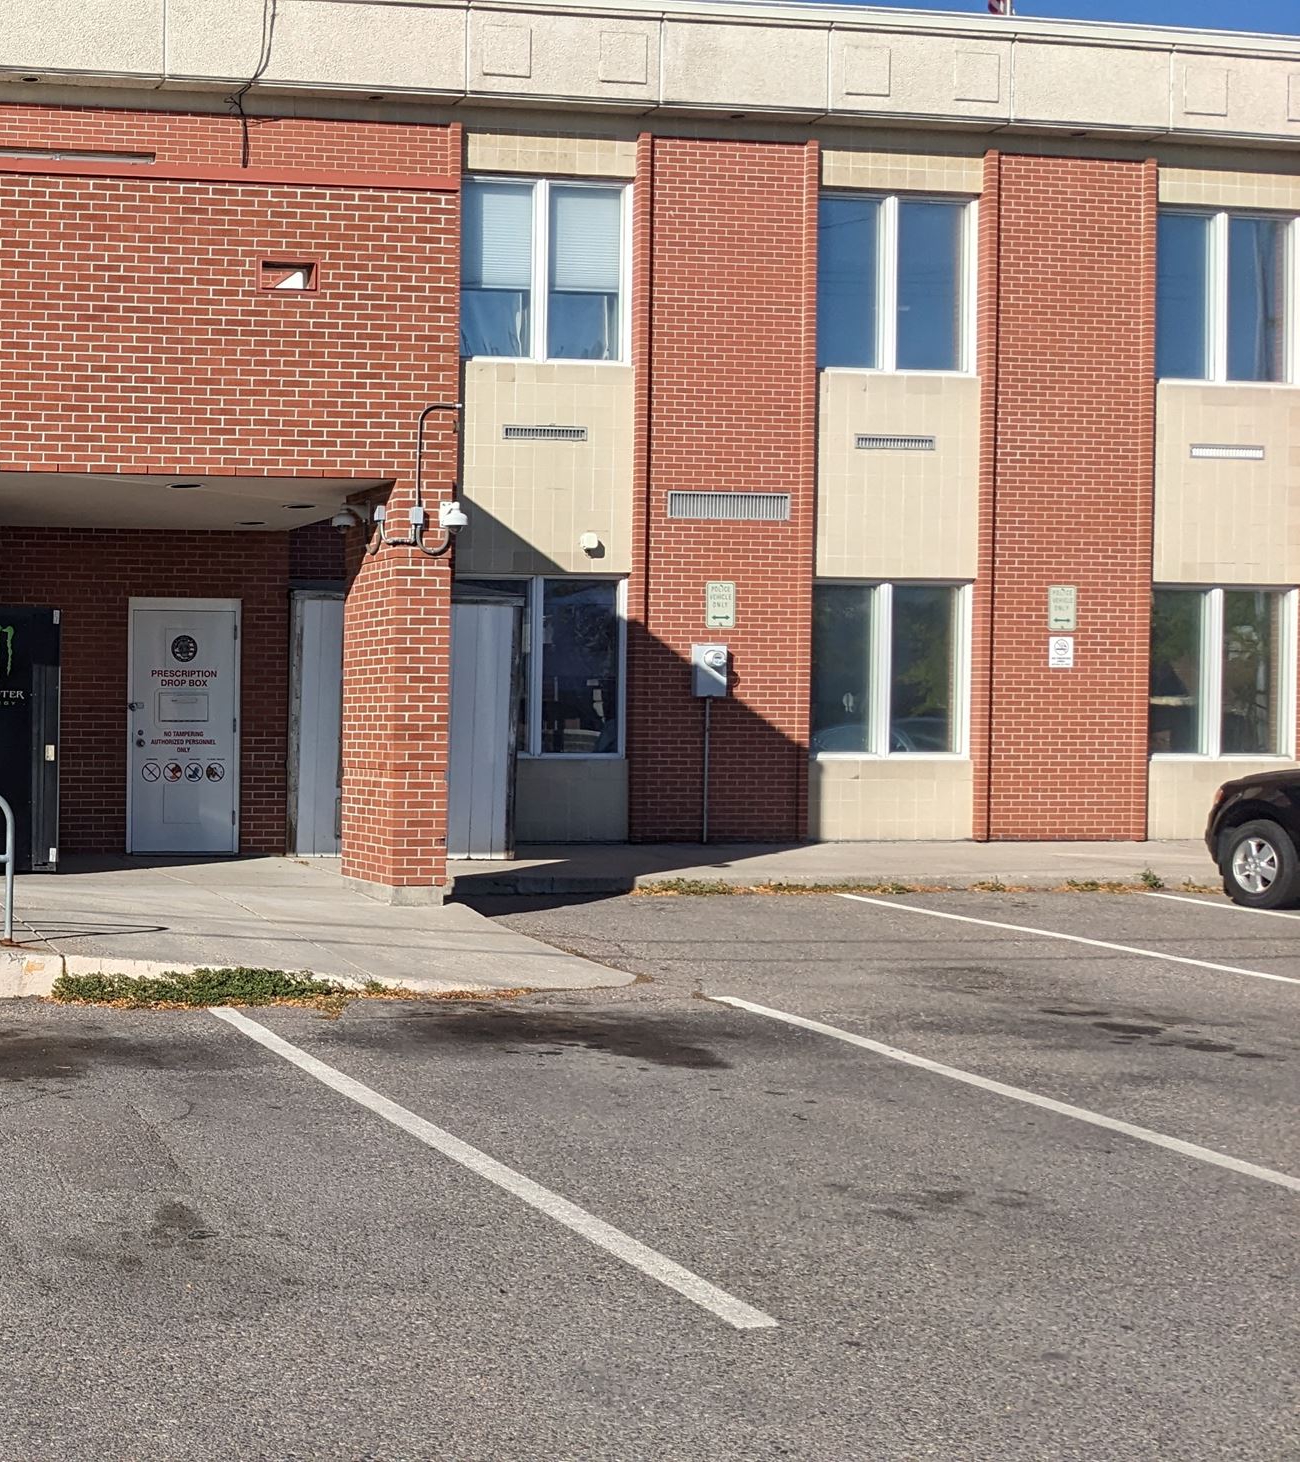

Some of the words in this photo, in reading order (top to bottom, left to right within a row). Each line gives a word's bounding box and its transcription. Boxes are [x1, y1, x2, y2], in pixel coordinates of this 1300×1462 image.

[151, 670, 218, 678] PRESCRIPTION
[161, 679, 186, 687] DROP
[189, 679, 208, 687] BOX
